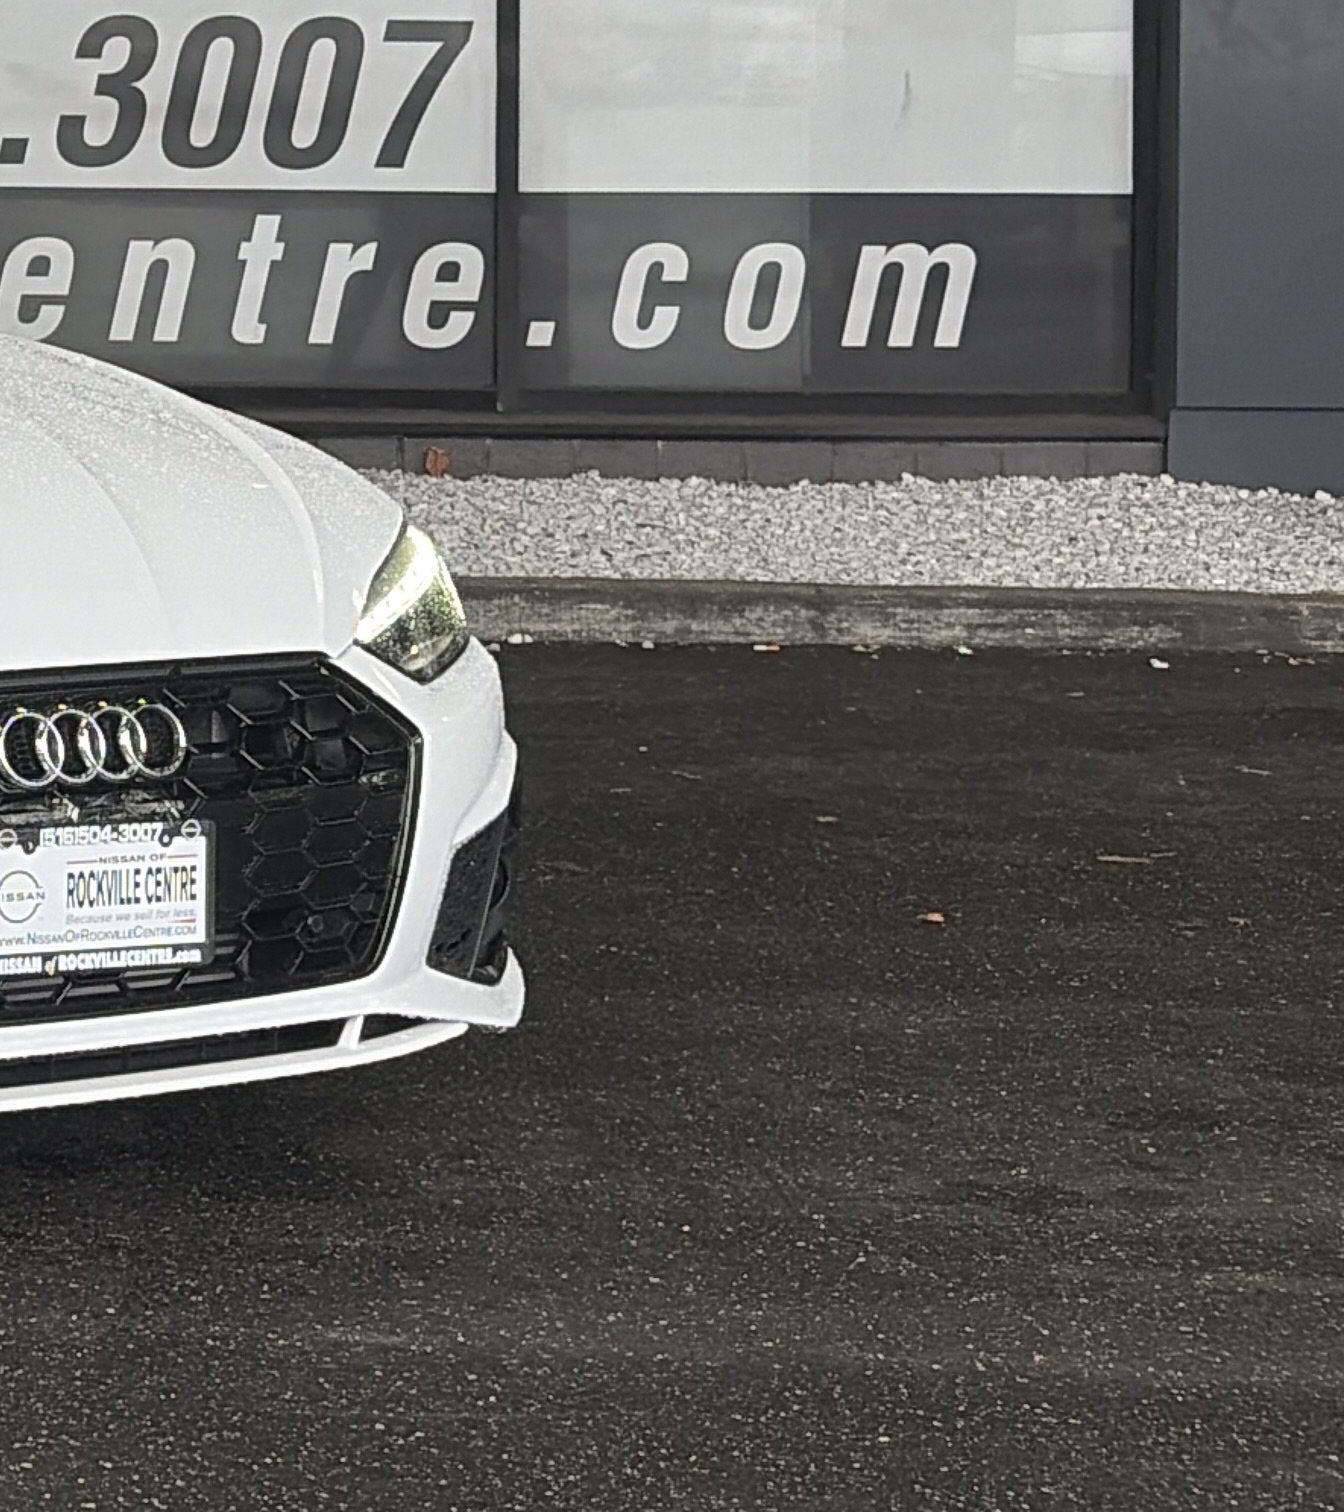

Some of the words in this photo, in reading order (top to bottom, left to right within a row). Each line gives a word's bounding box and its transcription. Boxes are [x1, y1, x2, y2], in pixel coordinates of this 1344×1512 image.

[98, 854, 146, 865] NISSAN
[149, 852, 167, 862] OF
[66, 868, 141, 909] ROCKVILLE
[145, 864, 197, 904] CENTRE
[65, 913, 113, 925] Because
[115, 912, 132, 922] we
